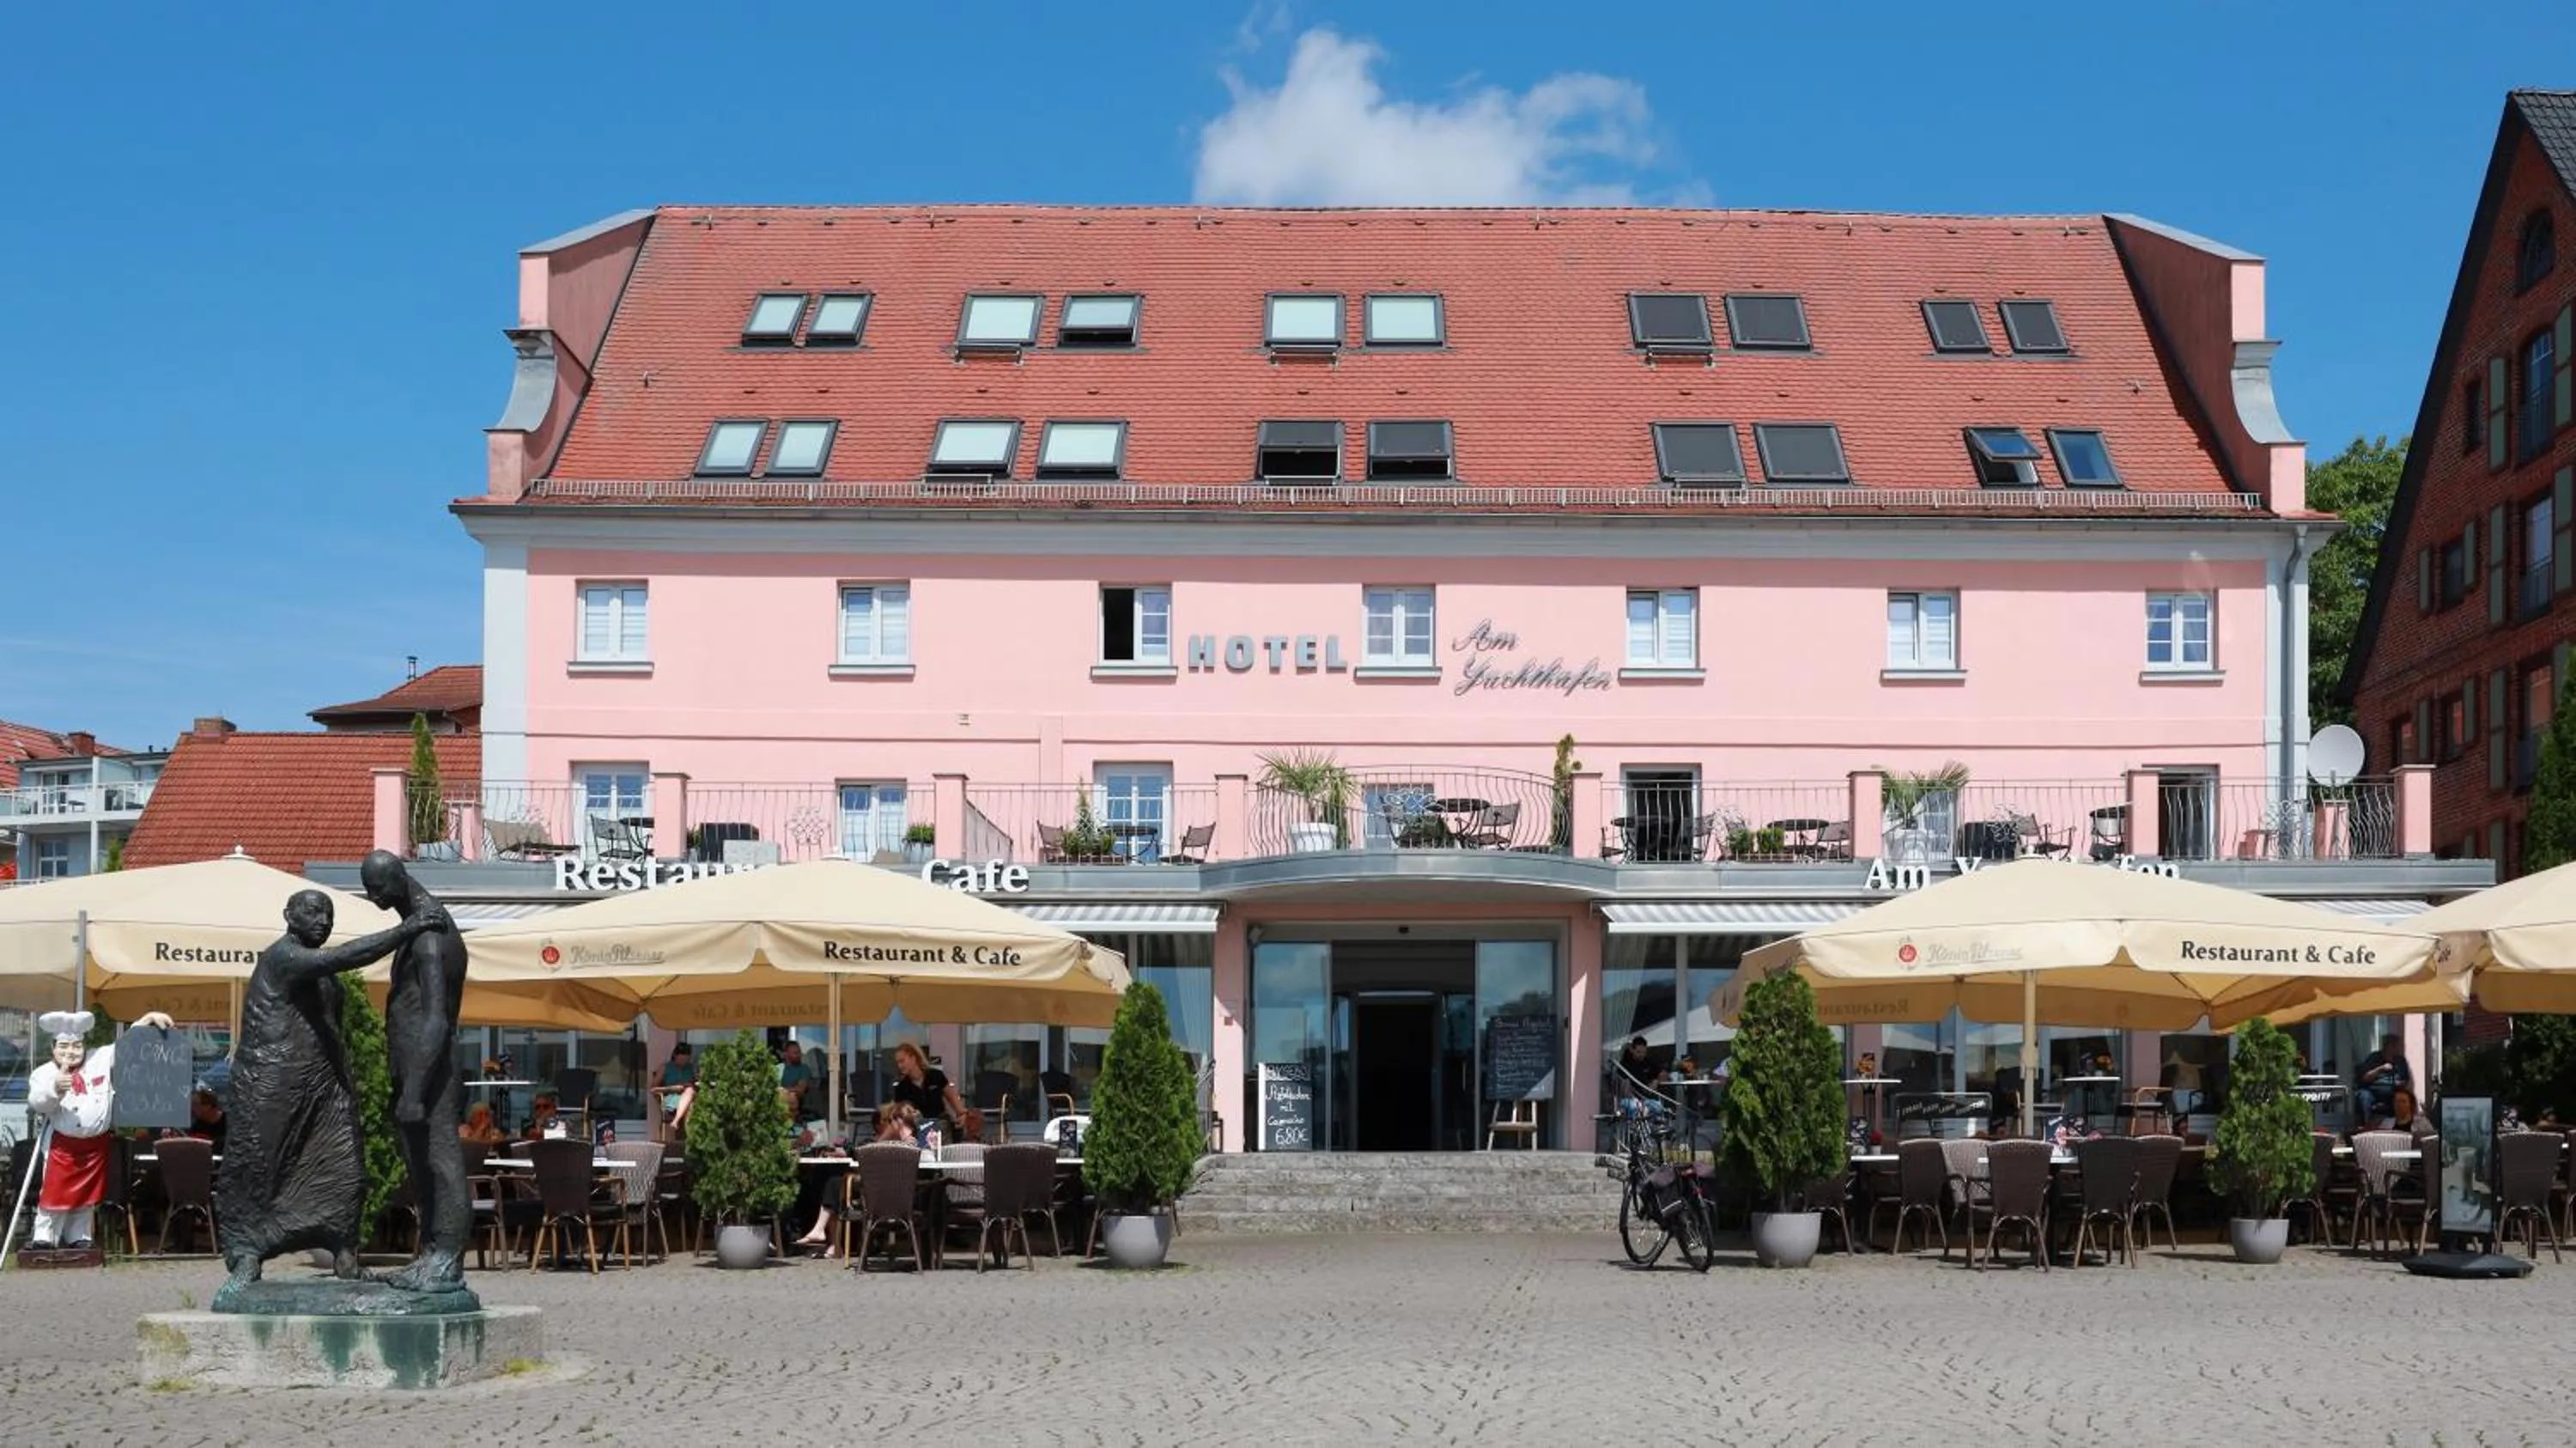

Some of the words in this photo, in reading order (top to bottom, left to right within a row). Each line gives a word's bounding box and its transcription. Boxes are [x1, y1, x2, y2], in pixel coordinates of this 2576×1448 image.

[1451, 618, 1517, 651] Am
[1188, 635, 1348, 674] HOTEL
[1863, 857, 1931, 890] Am
[155, 941, 262, 964] Restaura
[823, 940, 945, 963] Restaurant
[951, 945, 967, 964] &
[974, 945, 1022, 966] Cafe
[2181, 940, 2299, 963] Restaurant
[2305, 945, 2321, 964] &
[2327, 945, 2377, 964] Cafe
